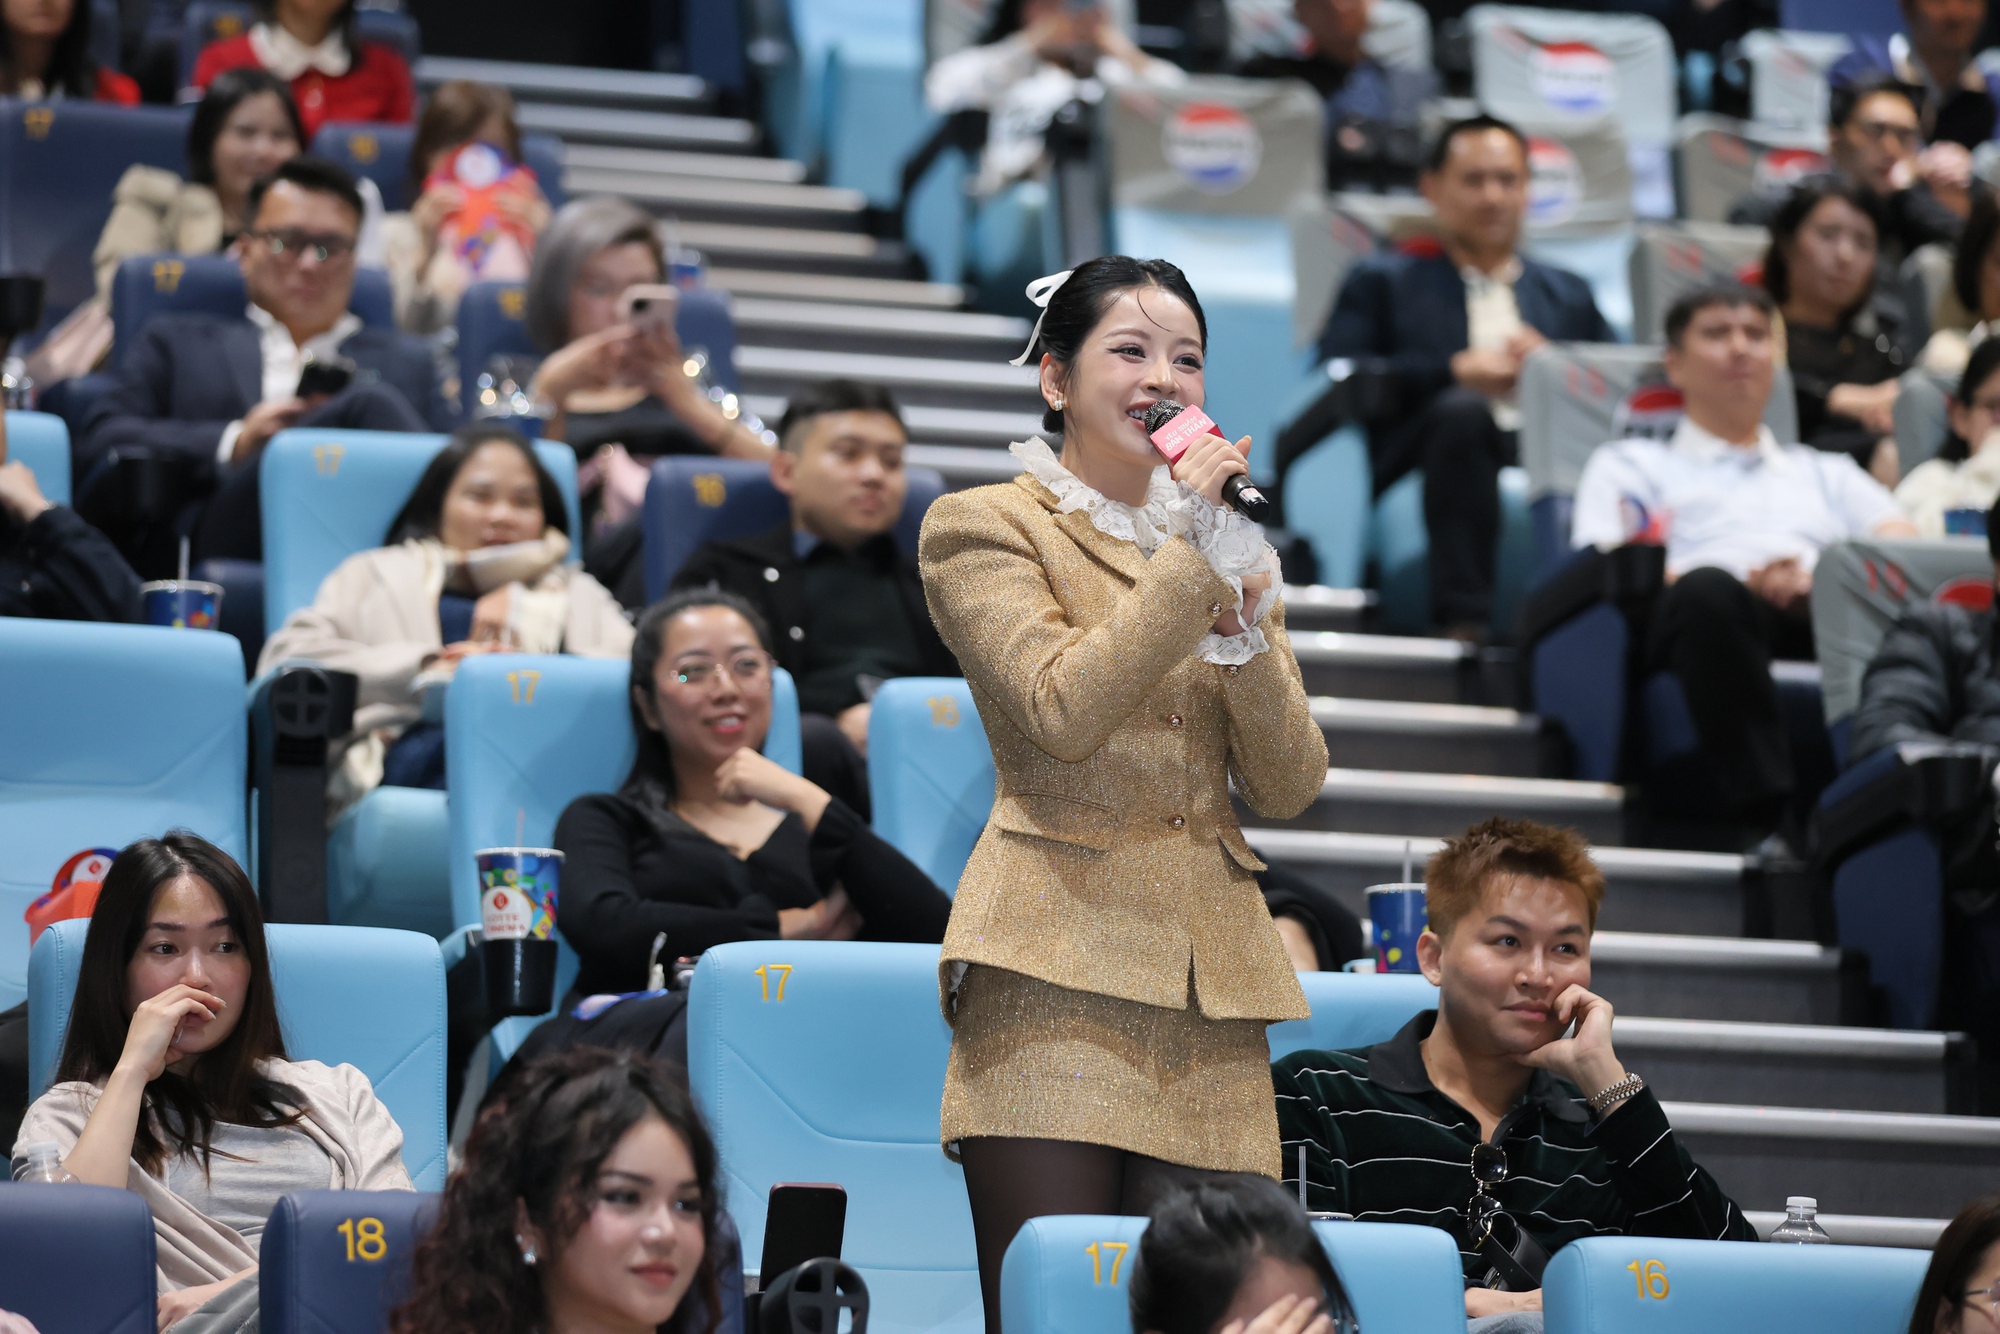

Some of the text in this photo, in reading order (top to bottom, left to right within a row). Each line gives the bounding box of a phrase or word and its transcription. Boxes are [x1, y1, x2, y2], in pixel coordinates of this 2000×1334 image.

[313, 443, 346, 477] 17
[506, 669, 542, 704] 17
[927, 694, 960, 728] 16
[754, 964, 794, 1002] 17
[337, 1216, 388, 1262] 18
[1085, 1241, 1129, 1286] 17
[1626, 1258, 1671, 1301] 16
